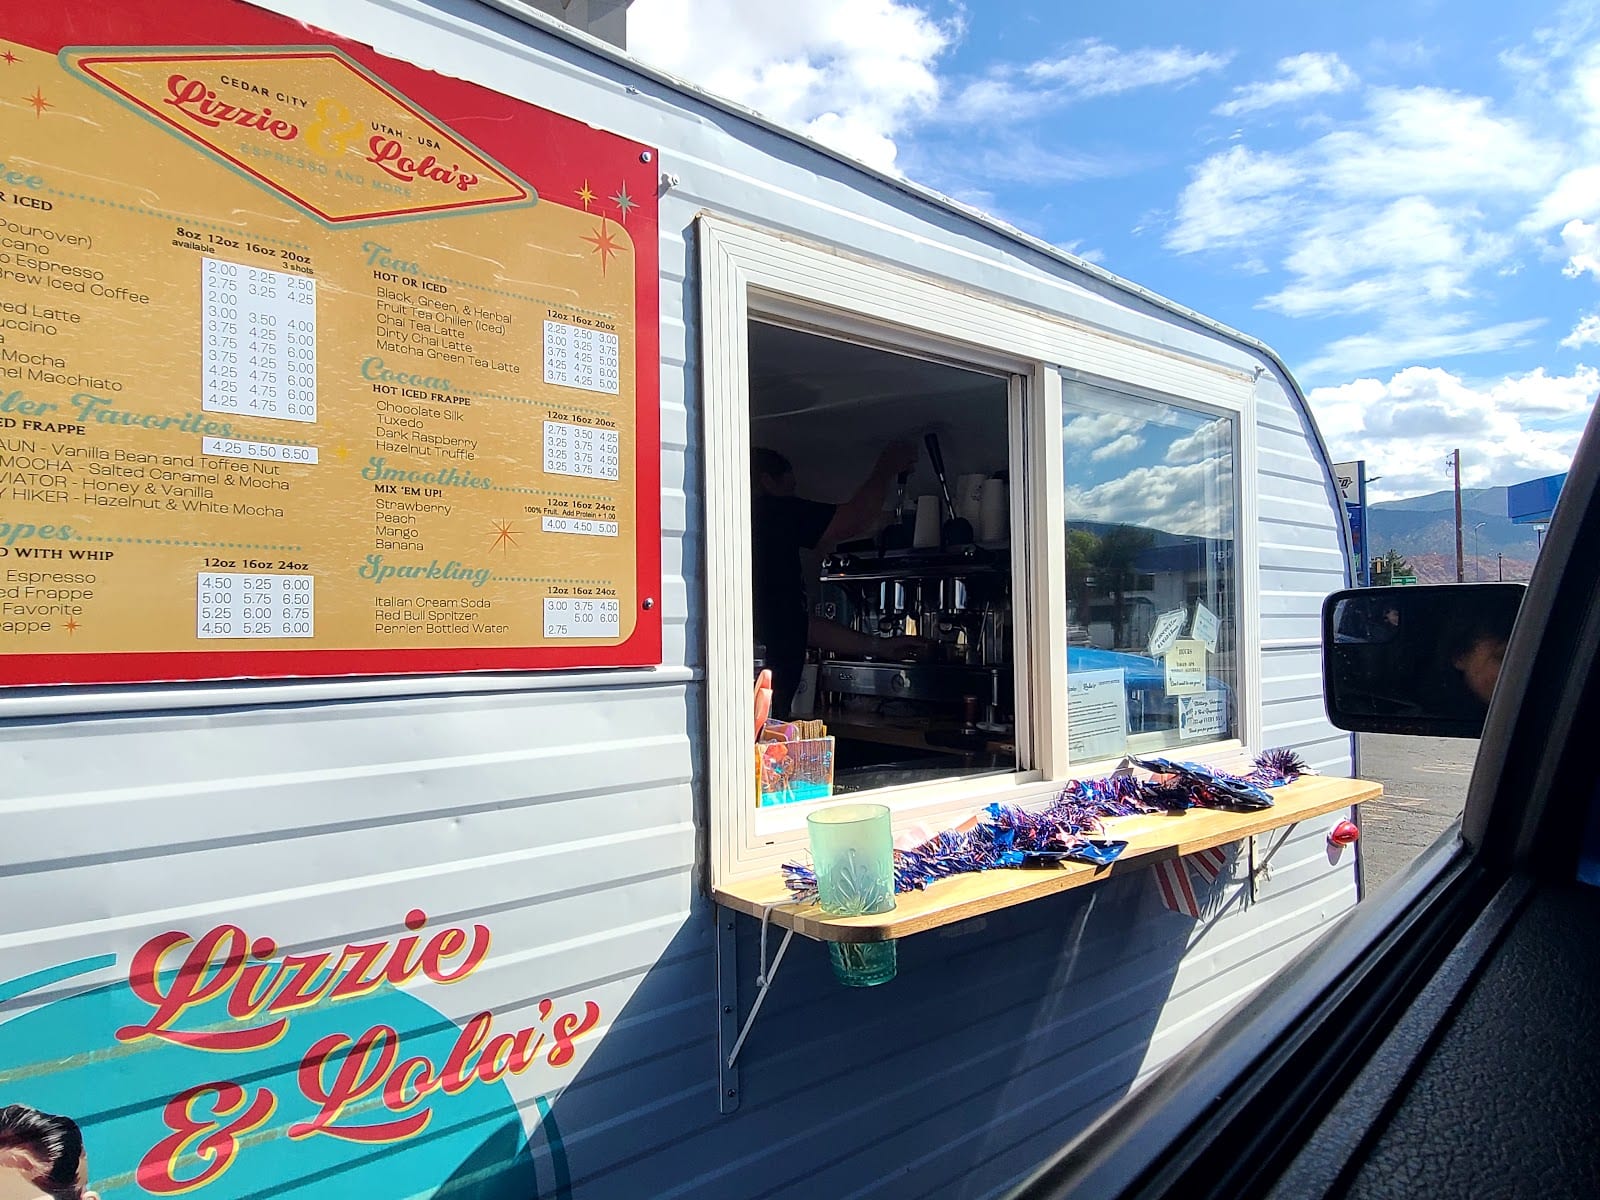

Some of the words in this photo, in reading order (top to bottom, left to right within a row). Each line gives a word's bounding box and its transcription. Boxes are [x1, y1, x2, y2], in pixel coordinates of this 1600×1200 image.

[221, 76, 269, 96] CEDAR
[276, 92, 308, 108] CITY
[163, 74, 298, 140] Lizzie
[305, 98, 364, 158] &
[371, 122, 403, 138] UTAH
[418, 136, 441, 150] USA
[240, 143, 328, 175] ESPRESSO
[335, 170, 365, 186] AND
[372, 180, 412, 198] MORE
[366, 135, 478, 192] Lola's
[14, 194, 53, 211] ICED
[172, 238, 216, 254] available
[176, 227, 202, 240] 8oz
[208, 234, 240, 249] 12oz
[246, 242, 276, 257] 16oz
[280, 250, 312, 264] 20oz
[16, 254, 104, 280] Espresso
[290, 264, 314, 274] shots
[362, 241, 420, 276] Teas
[209, 262, 237, 276] 2.00
[249, 270, 276, 284] 2.25
[287, 278, 314, 291] 2.50
[374, 270, 399, 284] HOT
[402, 277, 418, 288] OR
[422, 281, 448, 294] ICED
[48, 276, 85, 293] Iced
[90, 283, 150, 304] Coffee
[209, 276, 237, 291] 2.75
[249, 284, 276, 298] 3.25
[287, 291, 314, 305] 4.25
[209, 291, 237, 305] 2.00
[32, 304, 80, 323] Latte
[377, 286, 414, 304] Black,
[418, 296, 458, 312] Green,
[462, 306, 472, 316] &
[474, 308, 512, 324] Herbal
[209, 306, 237, 320] 3.00
[249, 312, 276, 326] 3.50
[287, 320, 314, 332] 4.00
[376, 313, 406, 327] Chai
[409, 320, 430, 332] Tea
[434, 324, 465, 339] Latte
[377, 300, 406, 316] Fruit
[410, 307, 432, 320] Tea
[436, 312, 473, 328] Chiller
[476, 320, 506, 336] (Iced)
[547, 310, 568, 320] 12oz
[572, 315, 592, 326] 16oz
[596, 320, 616, 331] 20oz
[209, 335, 237, 349] 3.75
[249, 342, 276, 355] 4.75
[287, 347, 314, 360] 6.00
[376, 326, 408, 343] Dirty
[412, 333, 439, 347] Chai
[442, 338, 473, 353] Latte
[2, 348, 66, 368] Mocha
[376, 340, 424, 357] Matcha
[427, 350, 465, 364] Green
[468, 355, 489, 368] Tea
[491, 360, 520, 374] Latte
[28, 368, 122, 392] Macchiato
[209, 365, 237, 378] 4.25
[249, 370, 276, 383] 4.75
[287, 375, 314, 388] 6.00
[360, 356, 450, 392] Cocoas
[209, 394, 237, 407] 4.25
[249, 400, 276, 412] 4.75
[287, 404, 314, 416] 6.00
[372, 384, 398, 396] HOT
[402, 388, 428, 400] ICED
[431, 394, 471, 406] FRAPPE
[71, 393, 233, 437] Favorites
[376, 400, 441, 419] Chocolate
[444, 410, 464, 422] Silk
[377, 414, 424, 428] Tuxedo
[22, 420, 86, 436] FRAPPE
[376, 427, 408, 440] Dark
[412, 432, 478, 450] Raspberry
[52, 443, 110, 460] Vanilla
[115, 450, 158, 464] Bean
[162, 456, 194, 468] and
[200, 458, 249, 472] Toffee
[253, 462, 280, 476] Nut
[212, 441, 242, 454] 4.25
[248, 444, 276, 458] 5.50
[282, 448, 309, 460] 6.50
[376, 440, 432, 456] Hazelnut
[435, 446, 475, 460] Truffle
[0, 454, 74, 472] MOCHA
[89, 462, 144, 478] Salted
[150, 468, 220, 484] Caramel
[224, 474, 235, 486] &
[239, 476, 290, 490] Mocha
[361, 456, 492, 490] Smoothies
[82, 478, 140, 496] Honey
[144, 482, 156, 494] &
[162, 484, 214, 498] Vanilla
[374, 484, 398, 494] MIX
[401, 486, 422, 496] 'EM
[424, 488, 442, 498] UP!
[12, 488, 69, 503] HIKER
[84, 493, 161, 510] Hazelnut
[165, 498, 178, 510] &
[182, 500, 229, 514] White
[233, 503, 284, 518] Mocha
[376, 498, 452, 516] Strawberry
[376, 512, 416, 524] Peach
[548, 519, 567, 529] 4.00
[574, 521, 592, 531] 4.50
[599, 523, 617, 534] 5.00
[376, 526, 419, 539] Mango
[14, 548, 62, 560] WITH
[68, 550, 114, 561] WHIP
[376, 538, 424, 550] Banana
[204, 558, 236, 568] 12oz
[242, 560, 273, 569] 16oz
[278, 560, 309, 570] 24oz
[358, 554, 491, 588] Sparkling
[6, 570, 96, 585] Espresso
[202, 578, 232, 589] 4.50
[243, 578, 272, 590] 5.25
[282, 580, 310, 590] 6.00
[25, 586, 94, 602] Frappe
[202, 592, 232, 604] 5.00
[243, 593, 272, 604] 5.75
[282, 594, 310, 604] 6.50
[375, 596, 413, 607] Italian
[416, 597, 458, 608] Cream
[460, 598, 491, 609] Soda
[2, 602, 83, 616] Favorite
[202, 608, 232, 619] 5.25
[243, 608, 272, 619] 6.00
[282, 608, 310, 619] 6.75
[375, 610, 401, 621] Red
[404, 610, 425, 621] Bull
[428, 611, 478, 623] Spritzer
[548, 601, 567, 610] 3.00
[574, 602, 593, 611] 3.75
[600, 602, 618, 611] 4.50
[375, 623, 423, 634] Perrier
[426, 623, 469, 634] Bottled
[472, 624, 510, 634] Water
[574, 613, 593, 623] 5.00
[600, 613, 618, 623] 6.00
[548, 625, 567, 635] 2.75
[115, 909, 490, 1052] Lizzie
[136, 1082, 278, 1196] &
[288, 999, 600, 1143] Lola's
